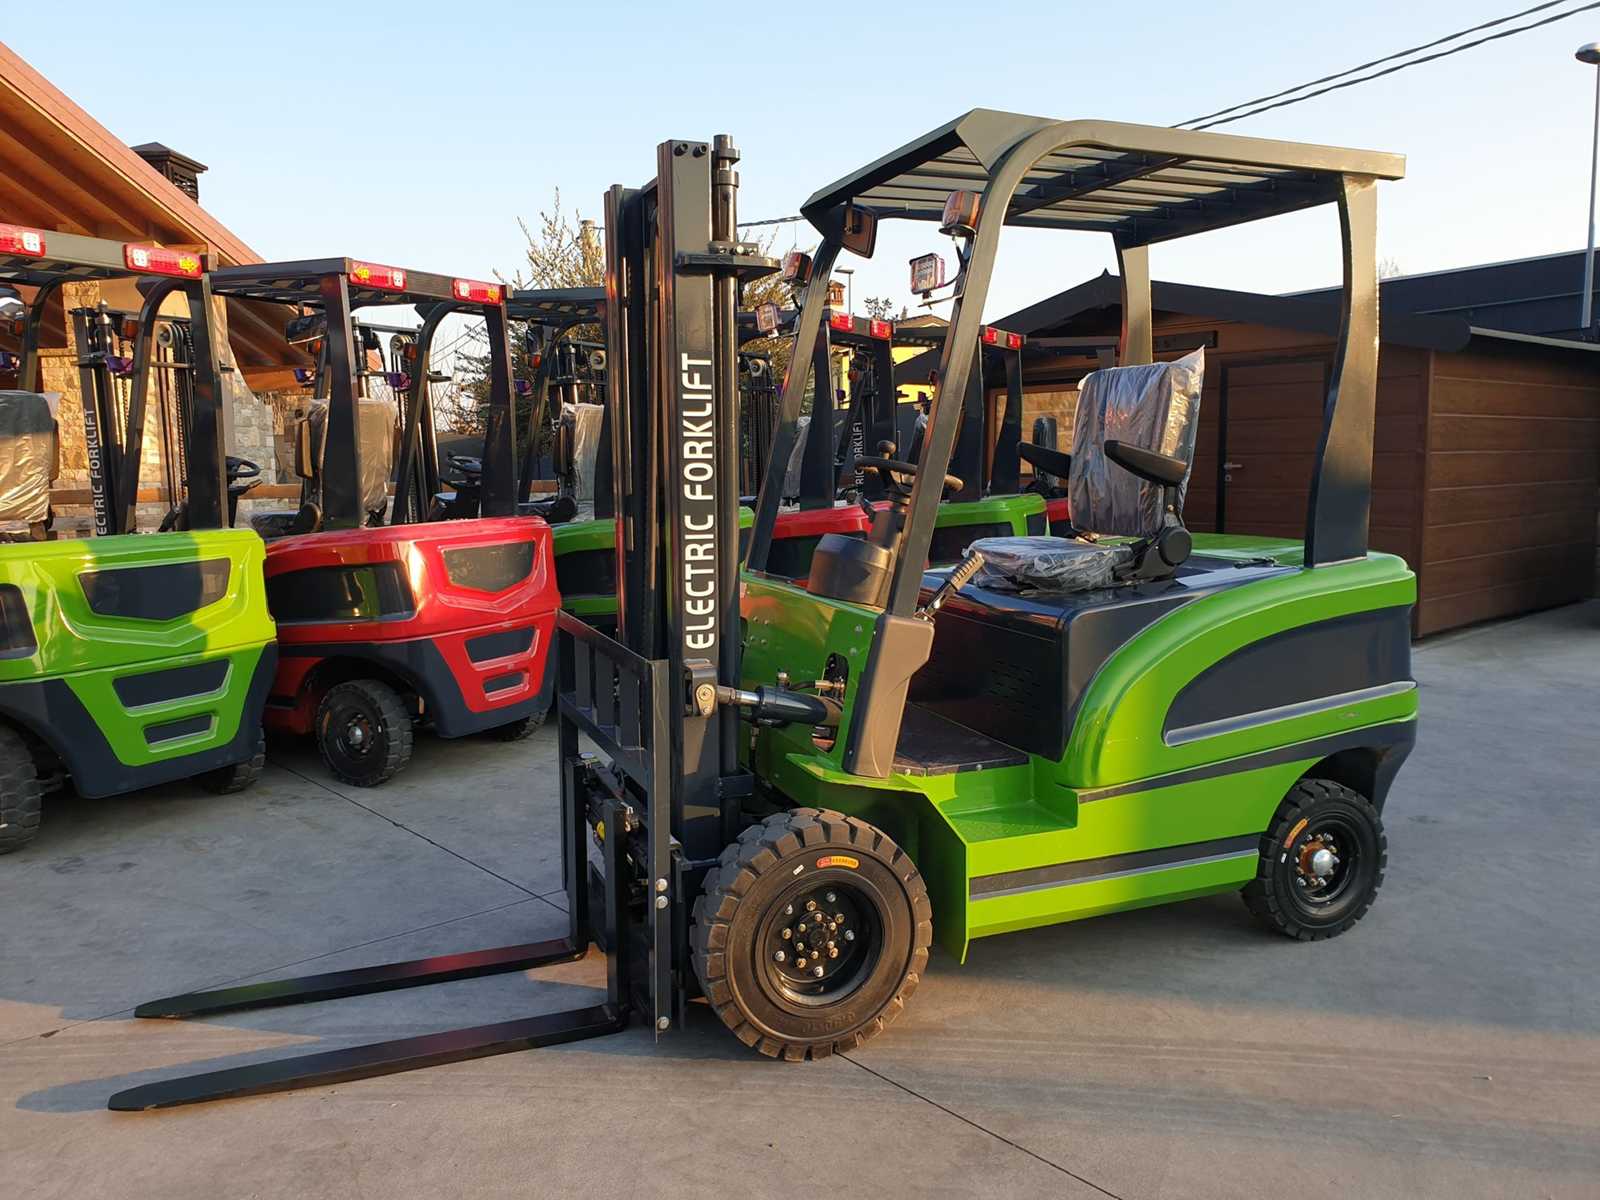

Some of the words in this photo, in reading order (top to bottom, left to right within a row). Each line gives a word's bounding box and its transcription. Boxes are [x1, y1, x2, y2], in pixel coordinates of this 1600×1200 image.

[84, 408, 102, 479] FORKLIFT
[681, 353, 714, 500] FORKLIFT
[92, 485, 107, 535] ECTRIC
[684, 514, 715, 649] ELECTRIC
